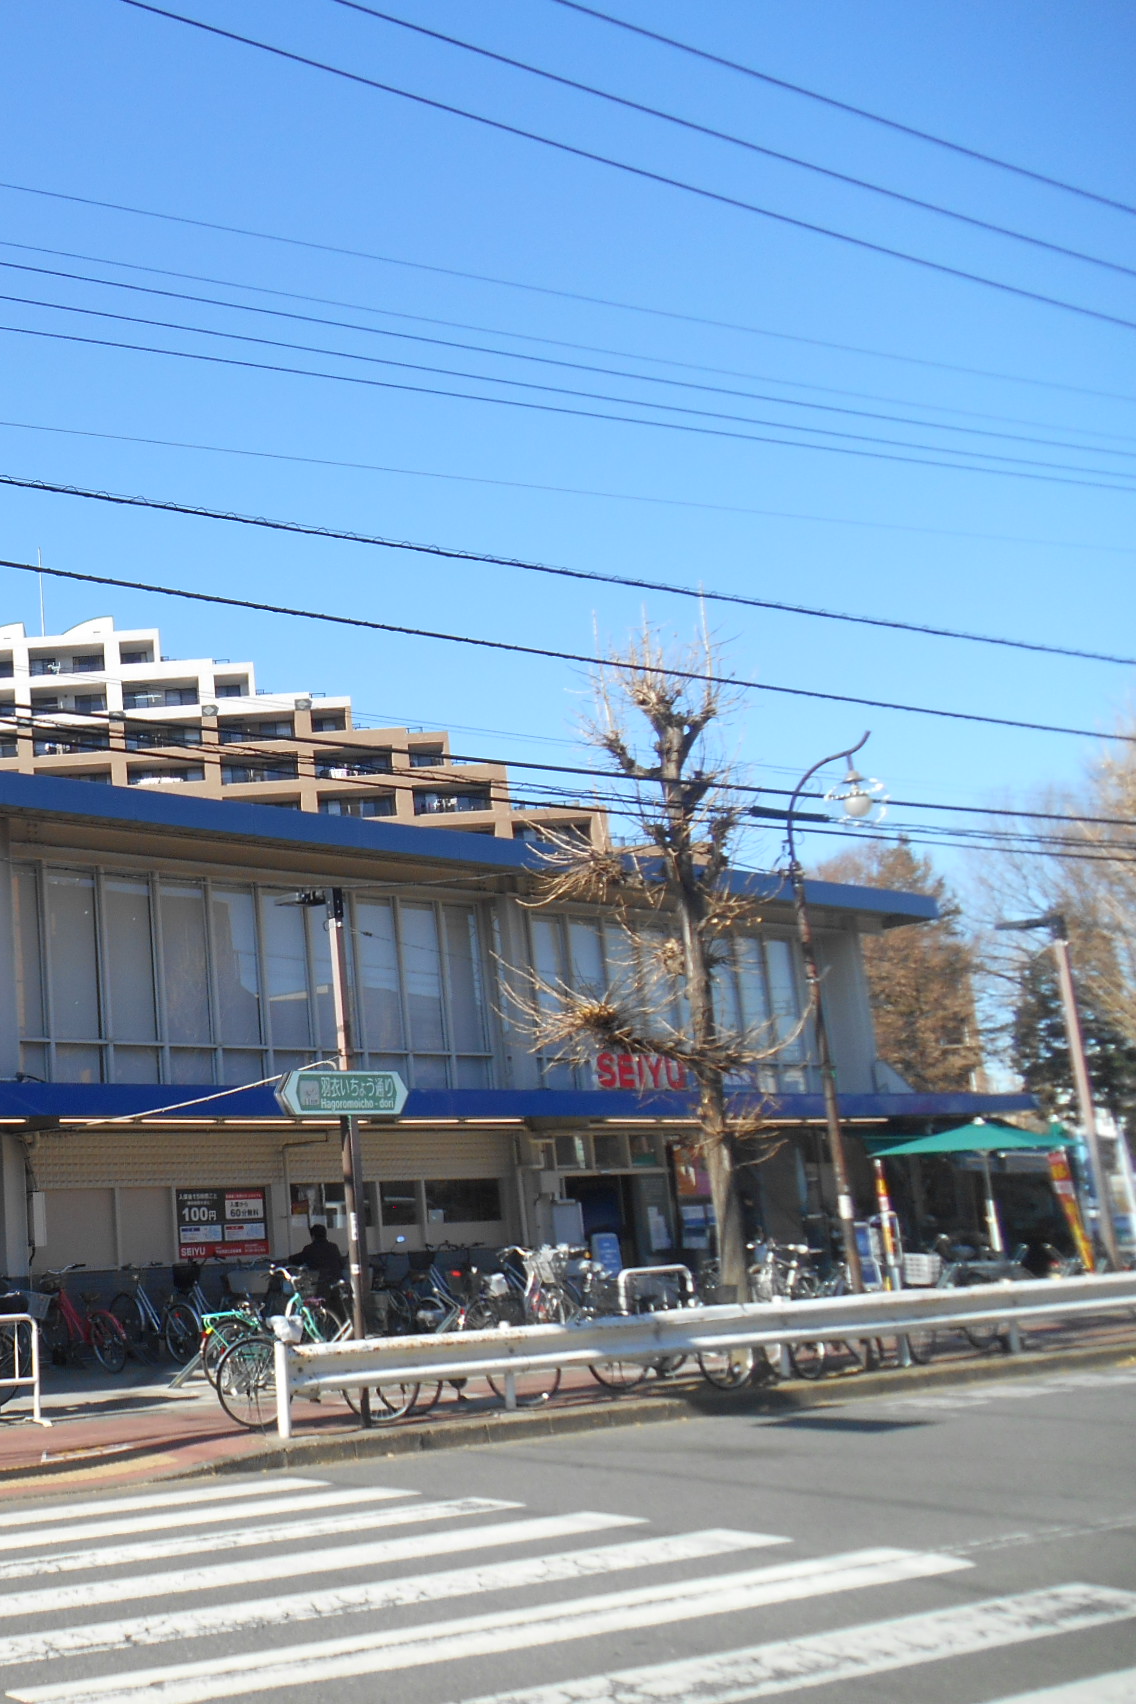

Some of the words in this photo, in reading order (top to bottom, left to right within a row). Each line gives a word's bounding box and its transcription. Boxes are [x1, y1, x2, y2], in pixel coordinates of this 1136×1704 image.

[596, 1051, 687, 1090] SEIYU
[320, 1077, 394, 1097] 羽衣いちょう通り
[182, 1206, 217, 1222] 100円
[180, 1246, 206, 1257] SEIYU
